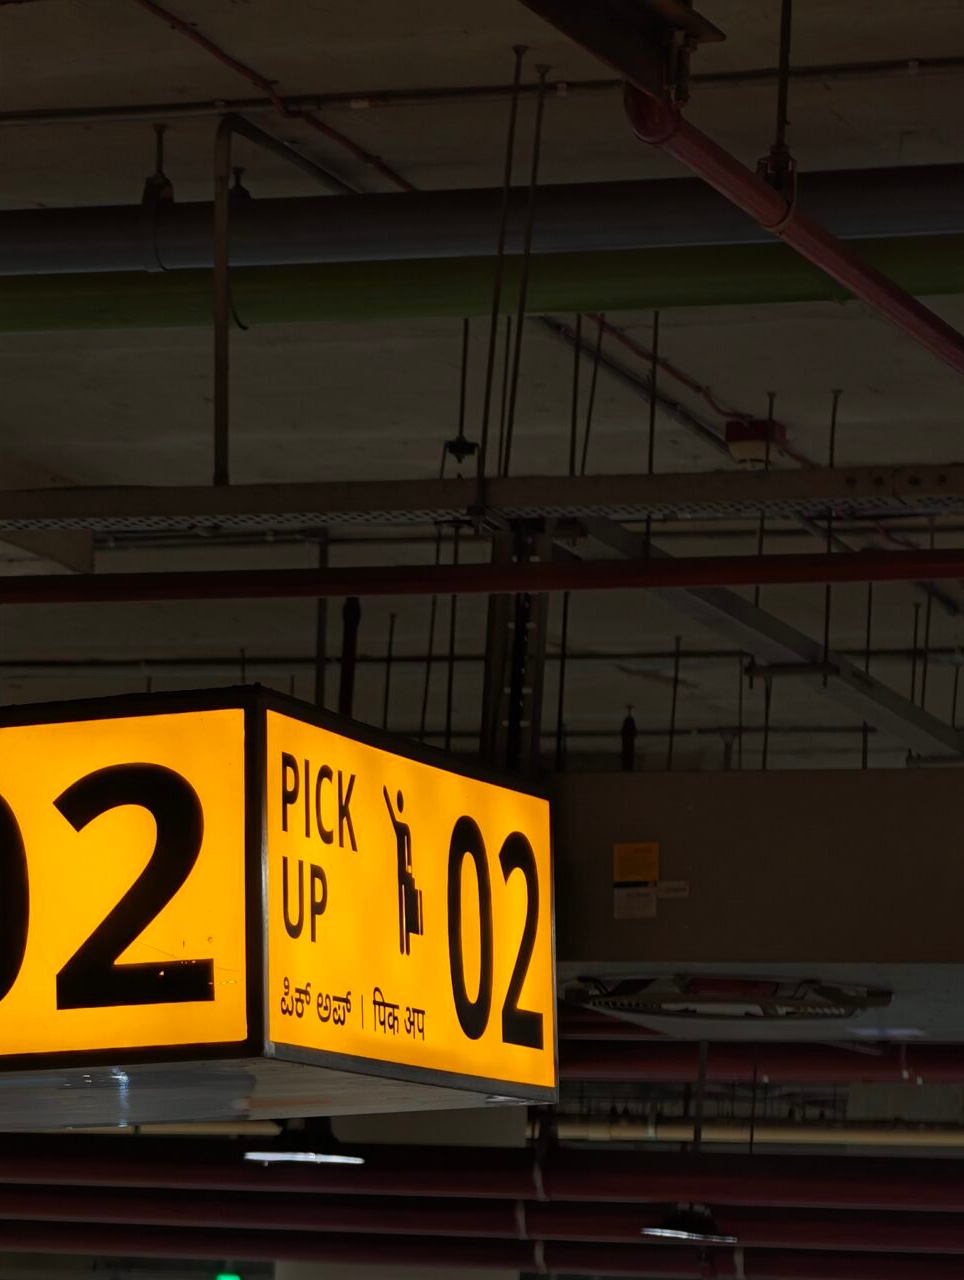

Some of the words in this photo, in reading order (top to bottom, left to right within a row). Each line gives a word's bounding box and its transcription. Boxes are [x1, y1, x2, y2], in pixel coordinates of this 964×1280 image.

[281, 751, 358, 852] PICK
[282, 856, 328, 943] UP
[446, 814, 544, 1050] 02
[280, 976, 311, 1018] ಪಿಕ್
[316, 991, 352, 1026] ಅಪ್
[372, 986, 400, 1035] पिक
[404, 1006, 426, 1041] अप
